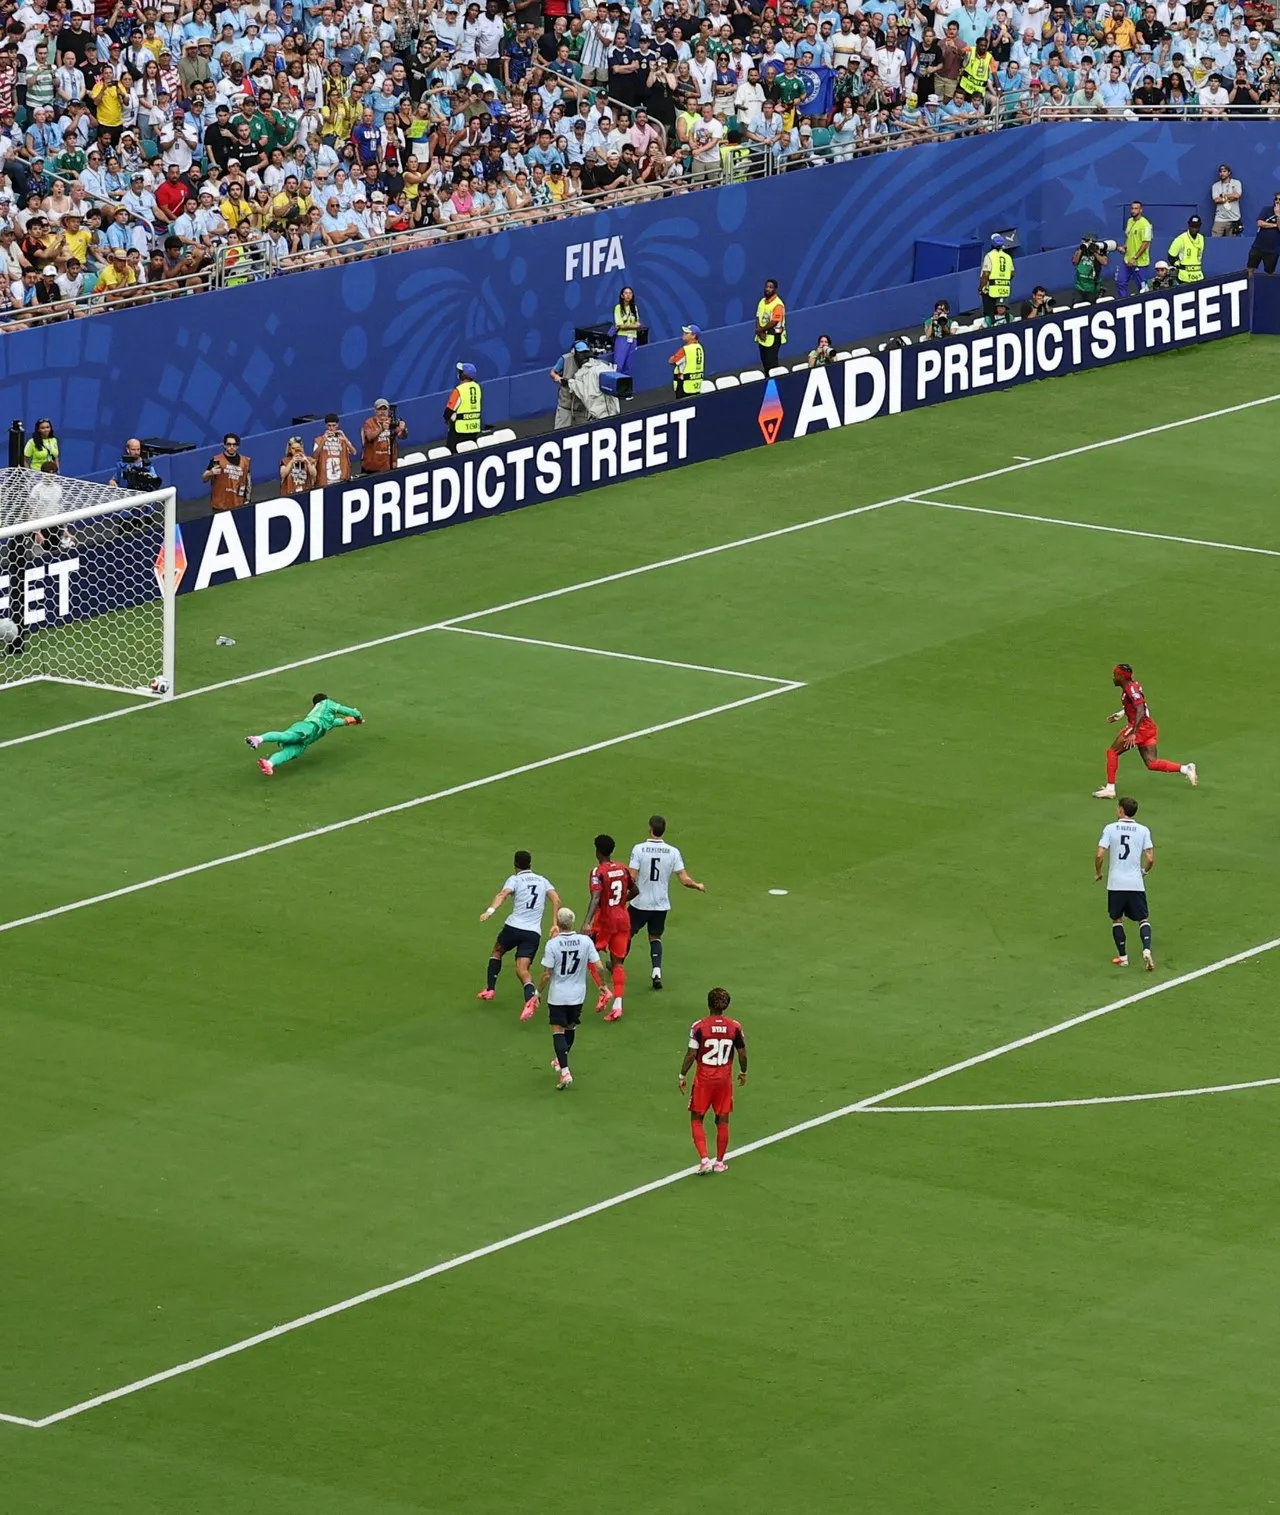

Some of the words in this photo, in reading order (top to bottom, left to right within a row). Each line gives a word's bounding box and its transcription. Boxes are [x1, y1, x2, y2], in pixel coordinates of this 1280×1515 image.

[565, 235, 626, 282] FIFA
[793, 347, 902, 438] ADI
[917, 280, 1248, 400] PREDICTSTREET
[194, 488, 324, 591] ADI
[342, 406, 697, 544] PREDICTSTREET
[1118, 834, 1131, 861] 5
[649, 857, 661, 882] 6
[525, 884, 539, 910] 3
[608, 880, 623, 907] 3
[560, 949, 581, 976] 13
[701, 1038, 734, 1067] 20
